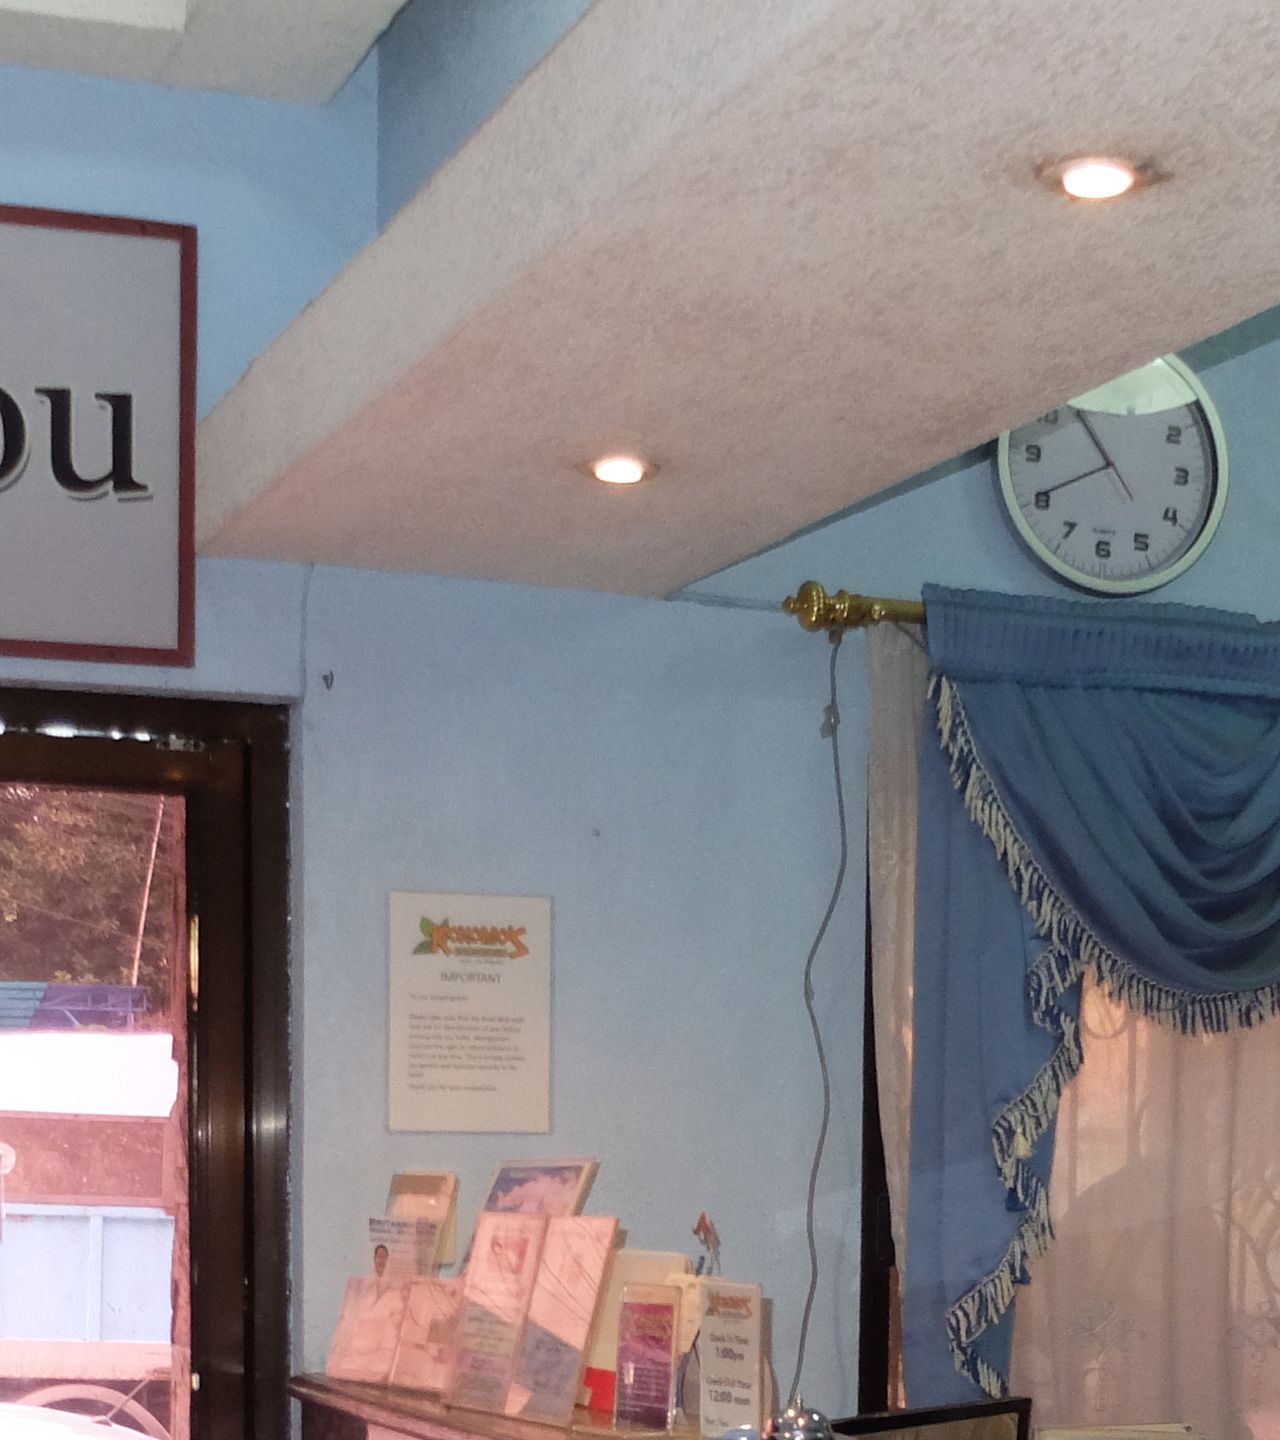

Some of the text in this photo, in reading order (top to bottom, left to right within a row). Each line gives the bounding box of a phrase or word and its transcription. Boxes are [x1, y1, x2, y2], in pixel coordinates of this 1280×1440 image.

[1165, 425, 1182, 445] 2
[1025, 444, 1041, 463] 9
[1174, 467, 1189, 486] 3
[1035, 491, 1050, 510] 8
[1162, 507, 1178, 526] 4
[1063, 521, 1077, 539] 7
[1095, 540, 1111, 559] 6
[1133, 533, 1149, 551] 5
[440, 972, 502, 984] IMPORTANT
